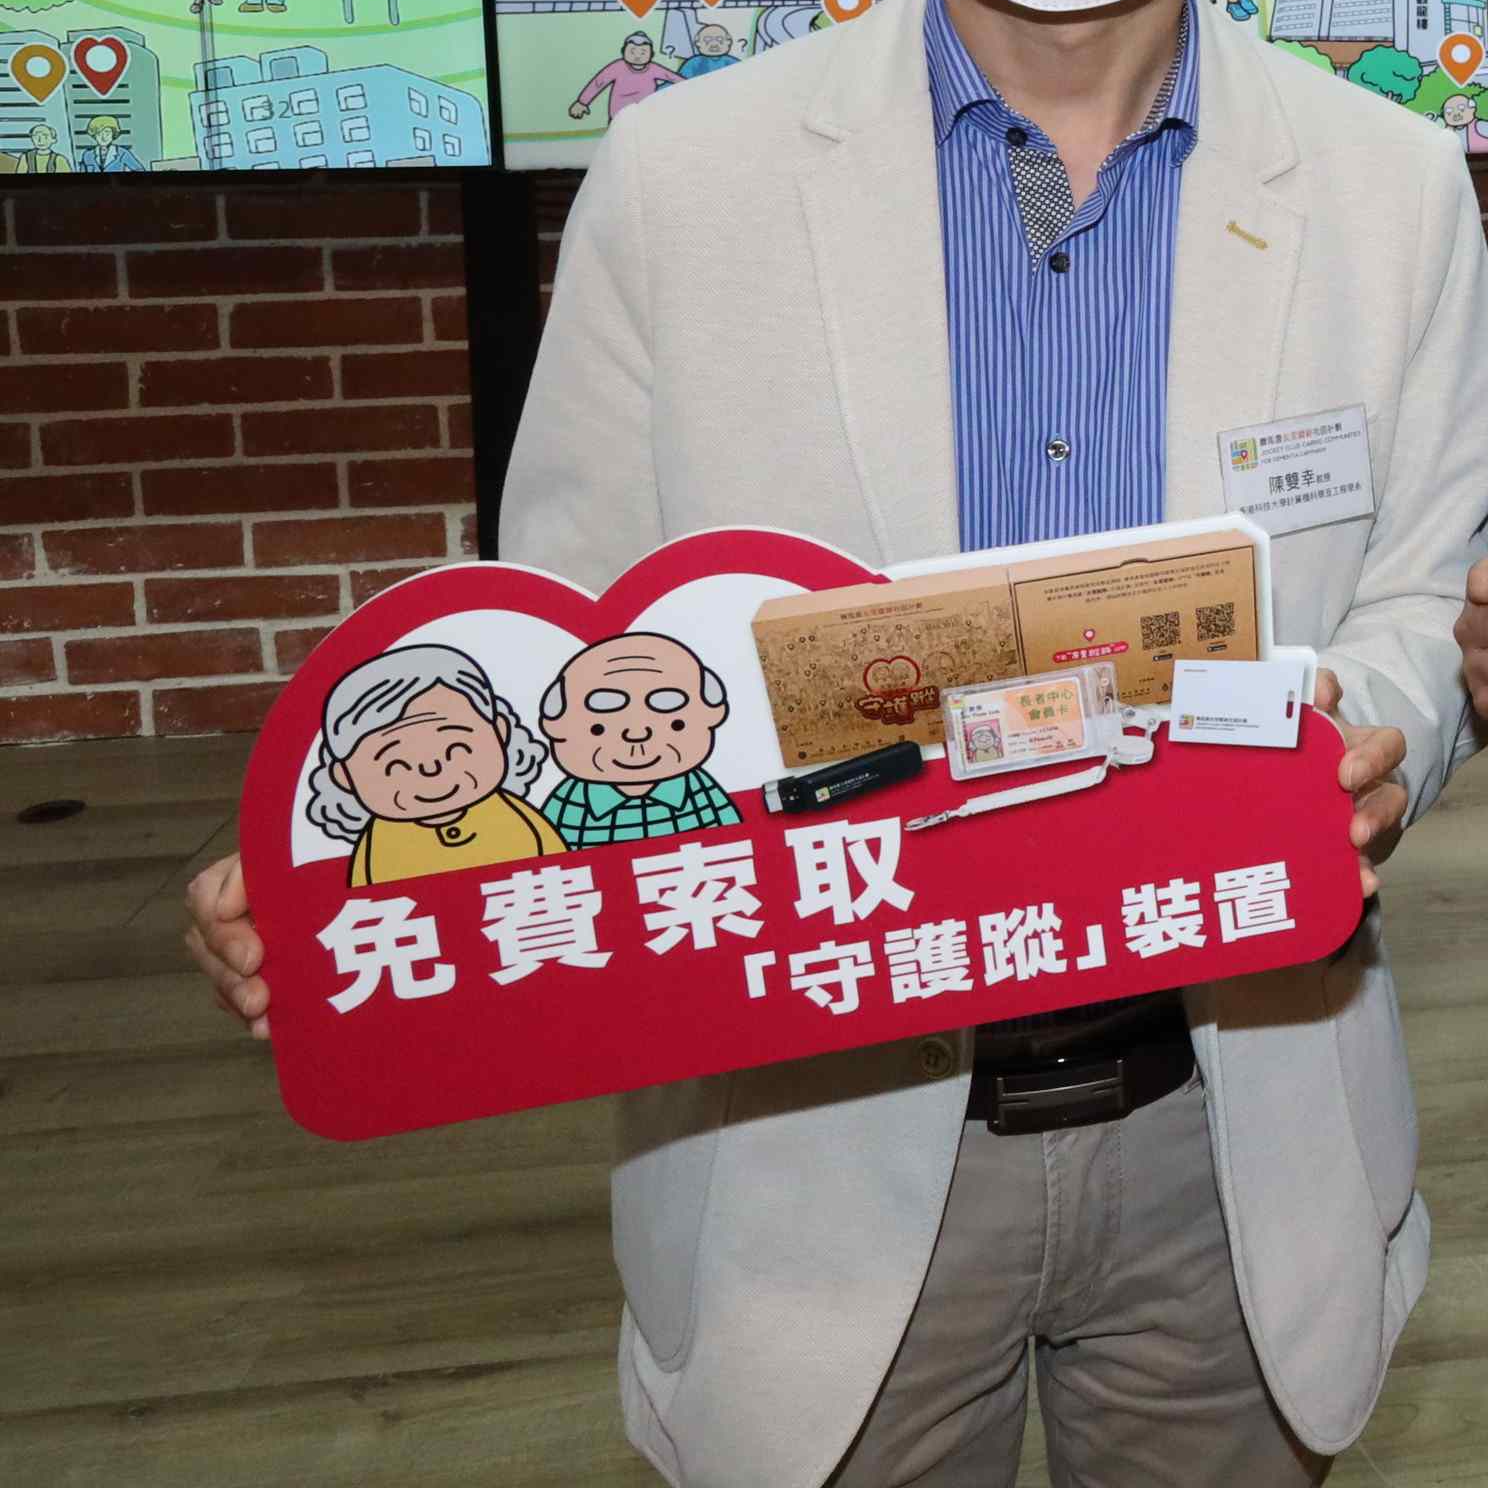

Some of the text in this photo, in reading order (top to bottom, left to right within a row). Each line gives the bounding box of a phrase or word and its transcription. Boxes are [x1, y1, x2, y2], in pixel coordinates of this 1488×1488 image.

[315, 817, 917, 1018] 免費索取
[742, 860, 1297, 1020] 「守護蹤」裝置
